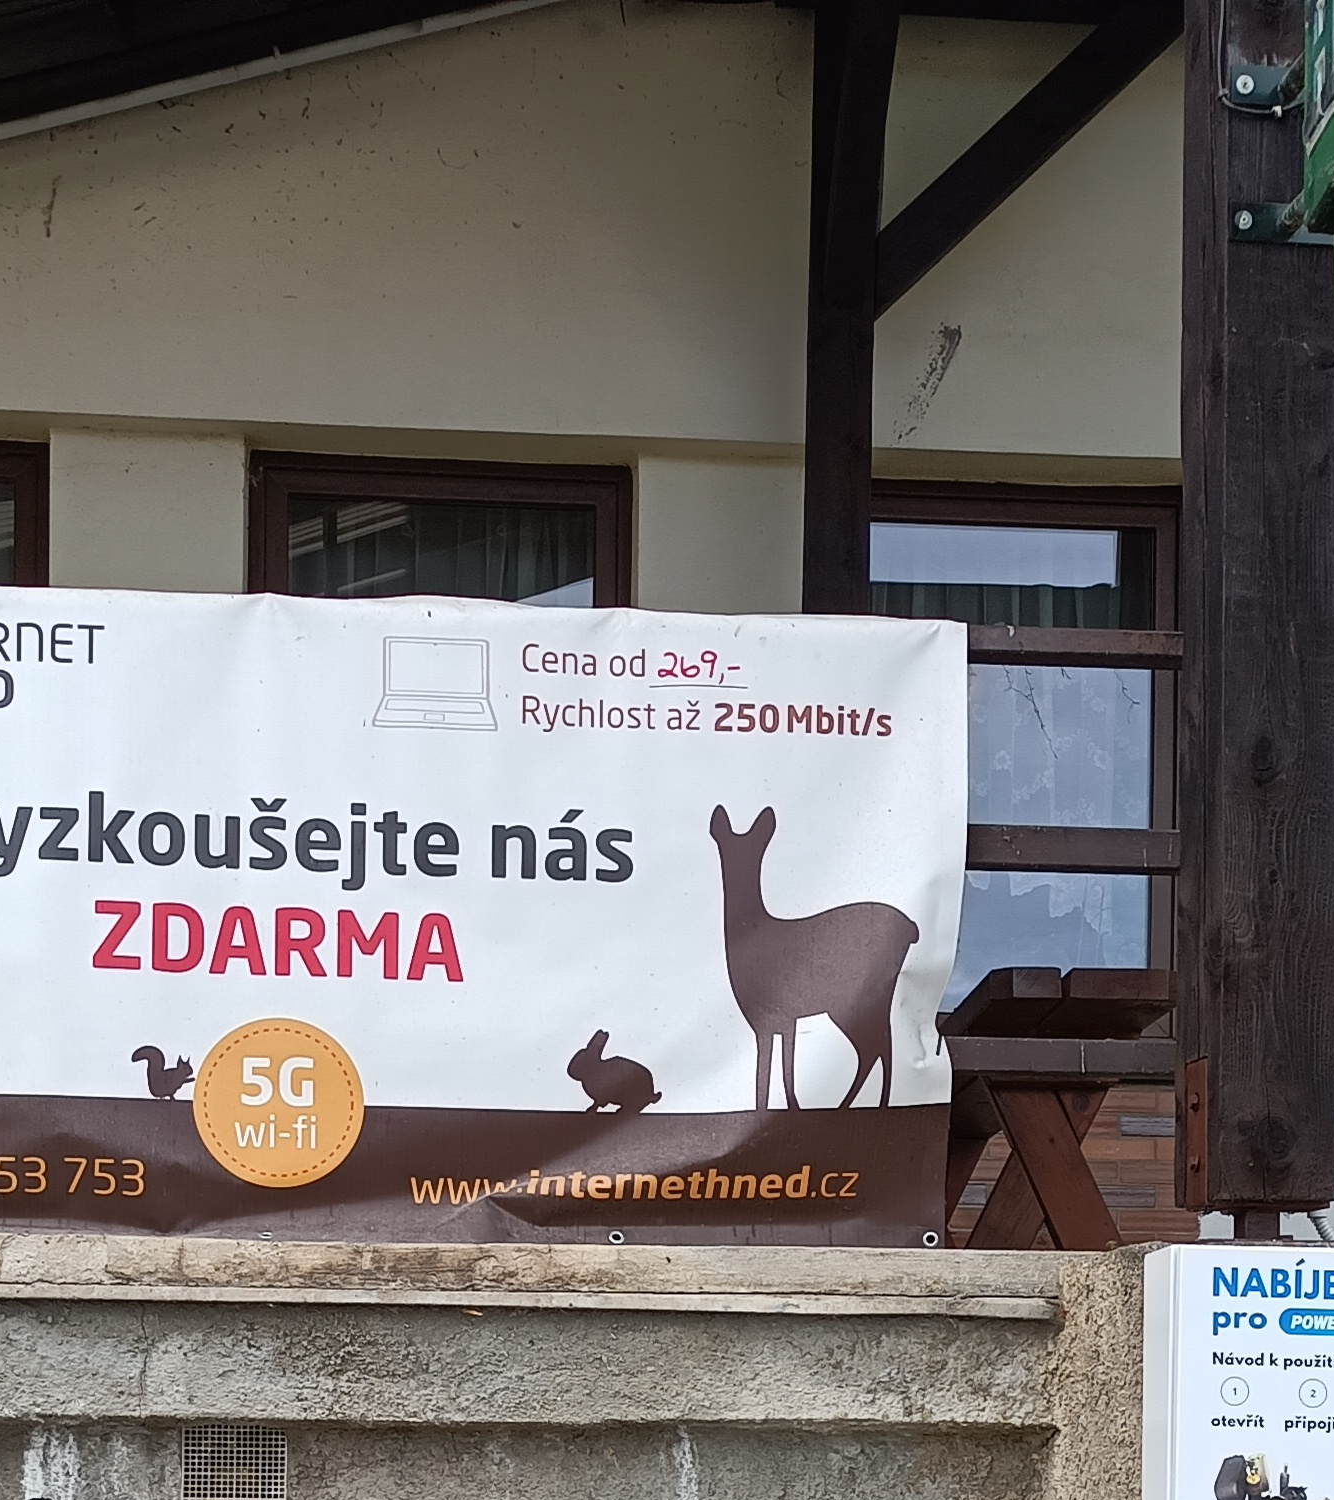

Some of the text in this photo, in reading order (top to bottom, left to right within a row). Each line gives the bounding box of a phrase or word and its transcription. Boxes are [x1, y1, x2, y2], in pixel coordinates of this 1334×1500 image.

[523, 644, 596, 676] Cena
[610, 649, 645, 677] od
[522, 696, 891, 736] Rychlost až 250 Mbit/s
[492, 809, 633, 882] nás
[93, 900, 464, 982] ZDARMA
[241, 1061, 315, 1108] 5G
[235, 1115, 318, 1150] wi-fi
[64, 1158, 145, 1197] 753
[410, 1165, 860, 1206] www.internethned.cz
[1213, 1312, 1267, 1336] pro
[1213, 1352, 1264, 1368] Návod
[1270, 1353, 1278, 1367] k
[1310, 1389, 1317, 1398] 2
[1211, 1415, 1264, 1430] otevřít
